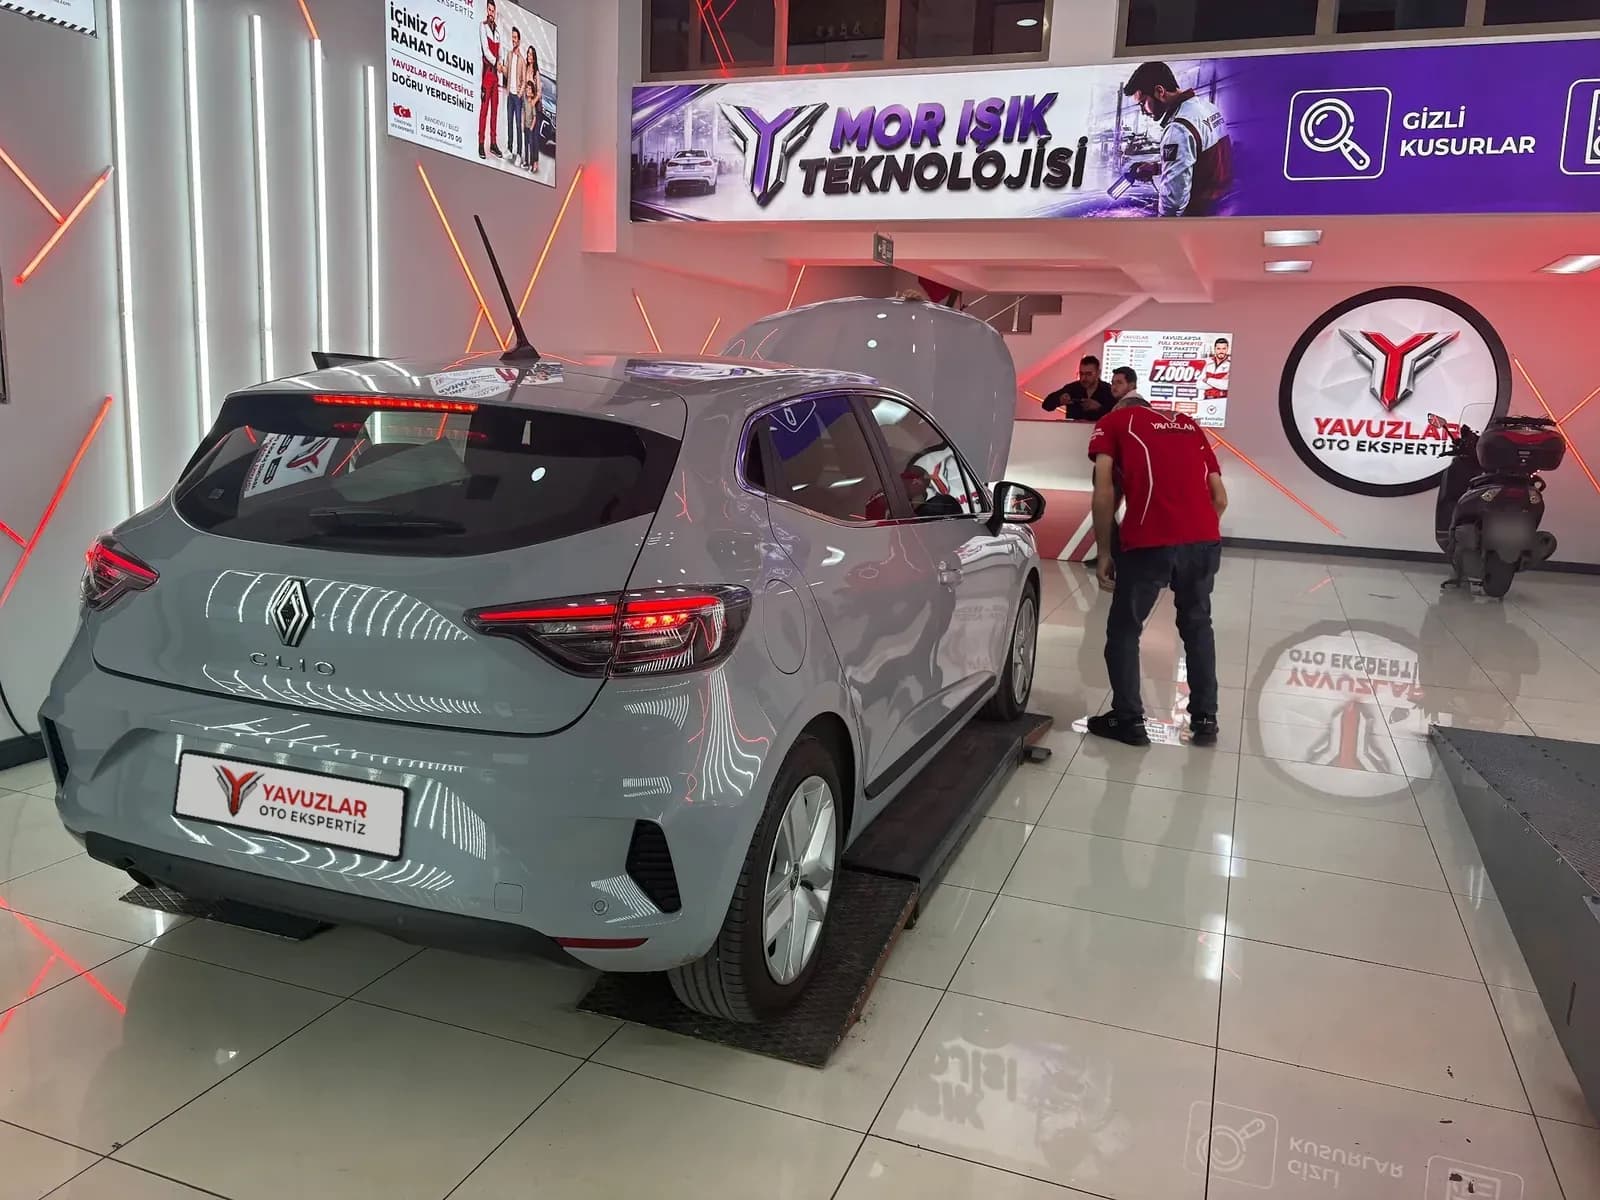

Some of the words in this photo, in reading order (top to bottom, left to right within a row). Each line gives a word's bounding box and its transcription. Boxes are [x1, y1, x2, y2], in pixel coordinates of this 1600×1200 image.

[390, 1, 428, 36] İÇİNİZ
[391, 26, 433, 57] RAHAT
[436, 48, 474, 76] OLSUN
[391, 57, 427, 79] YAVUZLAR
[428, 72, 474, 98] GÜVENCESİYLE
[392, 72, 423, 93] DOĞRU
[425, 85, 474, 112] YERDESİNİZ!
[829, 102, 945, 151] MOR
[956, 92, 1059, 152] IŞIK
[1402, 105, 1466, 130] GİZLİ
[1399, 135, 1536, 157] KUSURLAR
[799, 136, 1089, 196] TEKNOLOJİSİ
[1150, 422, 1196, 432] YAVUZLAR
[1314, 417, 1460, 441] YAVUZLAR
[1312, 437, 1350, 451] OTO
[249, 652, 336, 676] CLIO
[262, 783, 368, 819] YAVUZLAR
[259, 805, 287, 820] OTO
[290, 810, 367, 836] EKSPERTİZ
